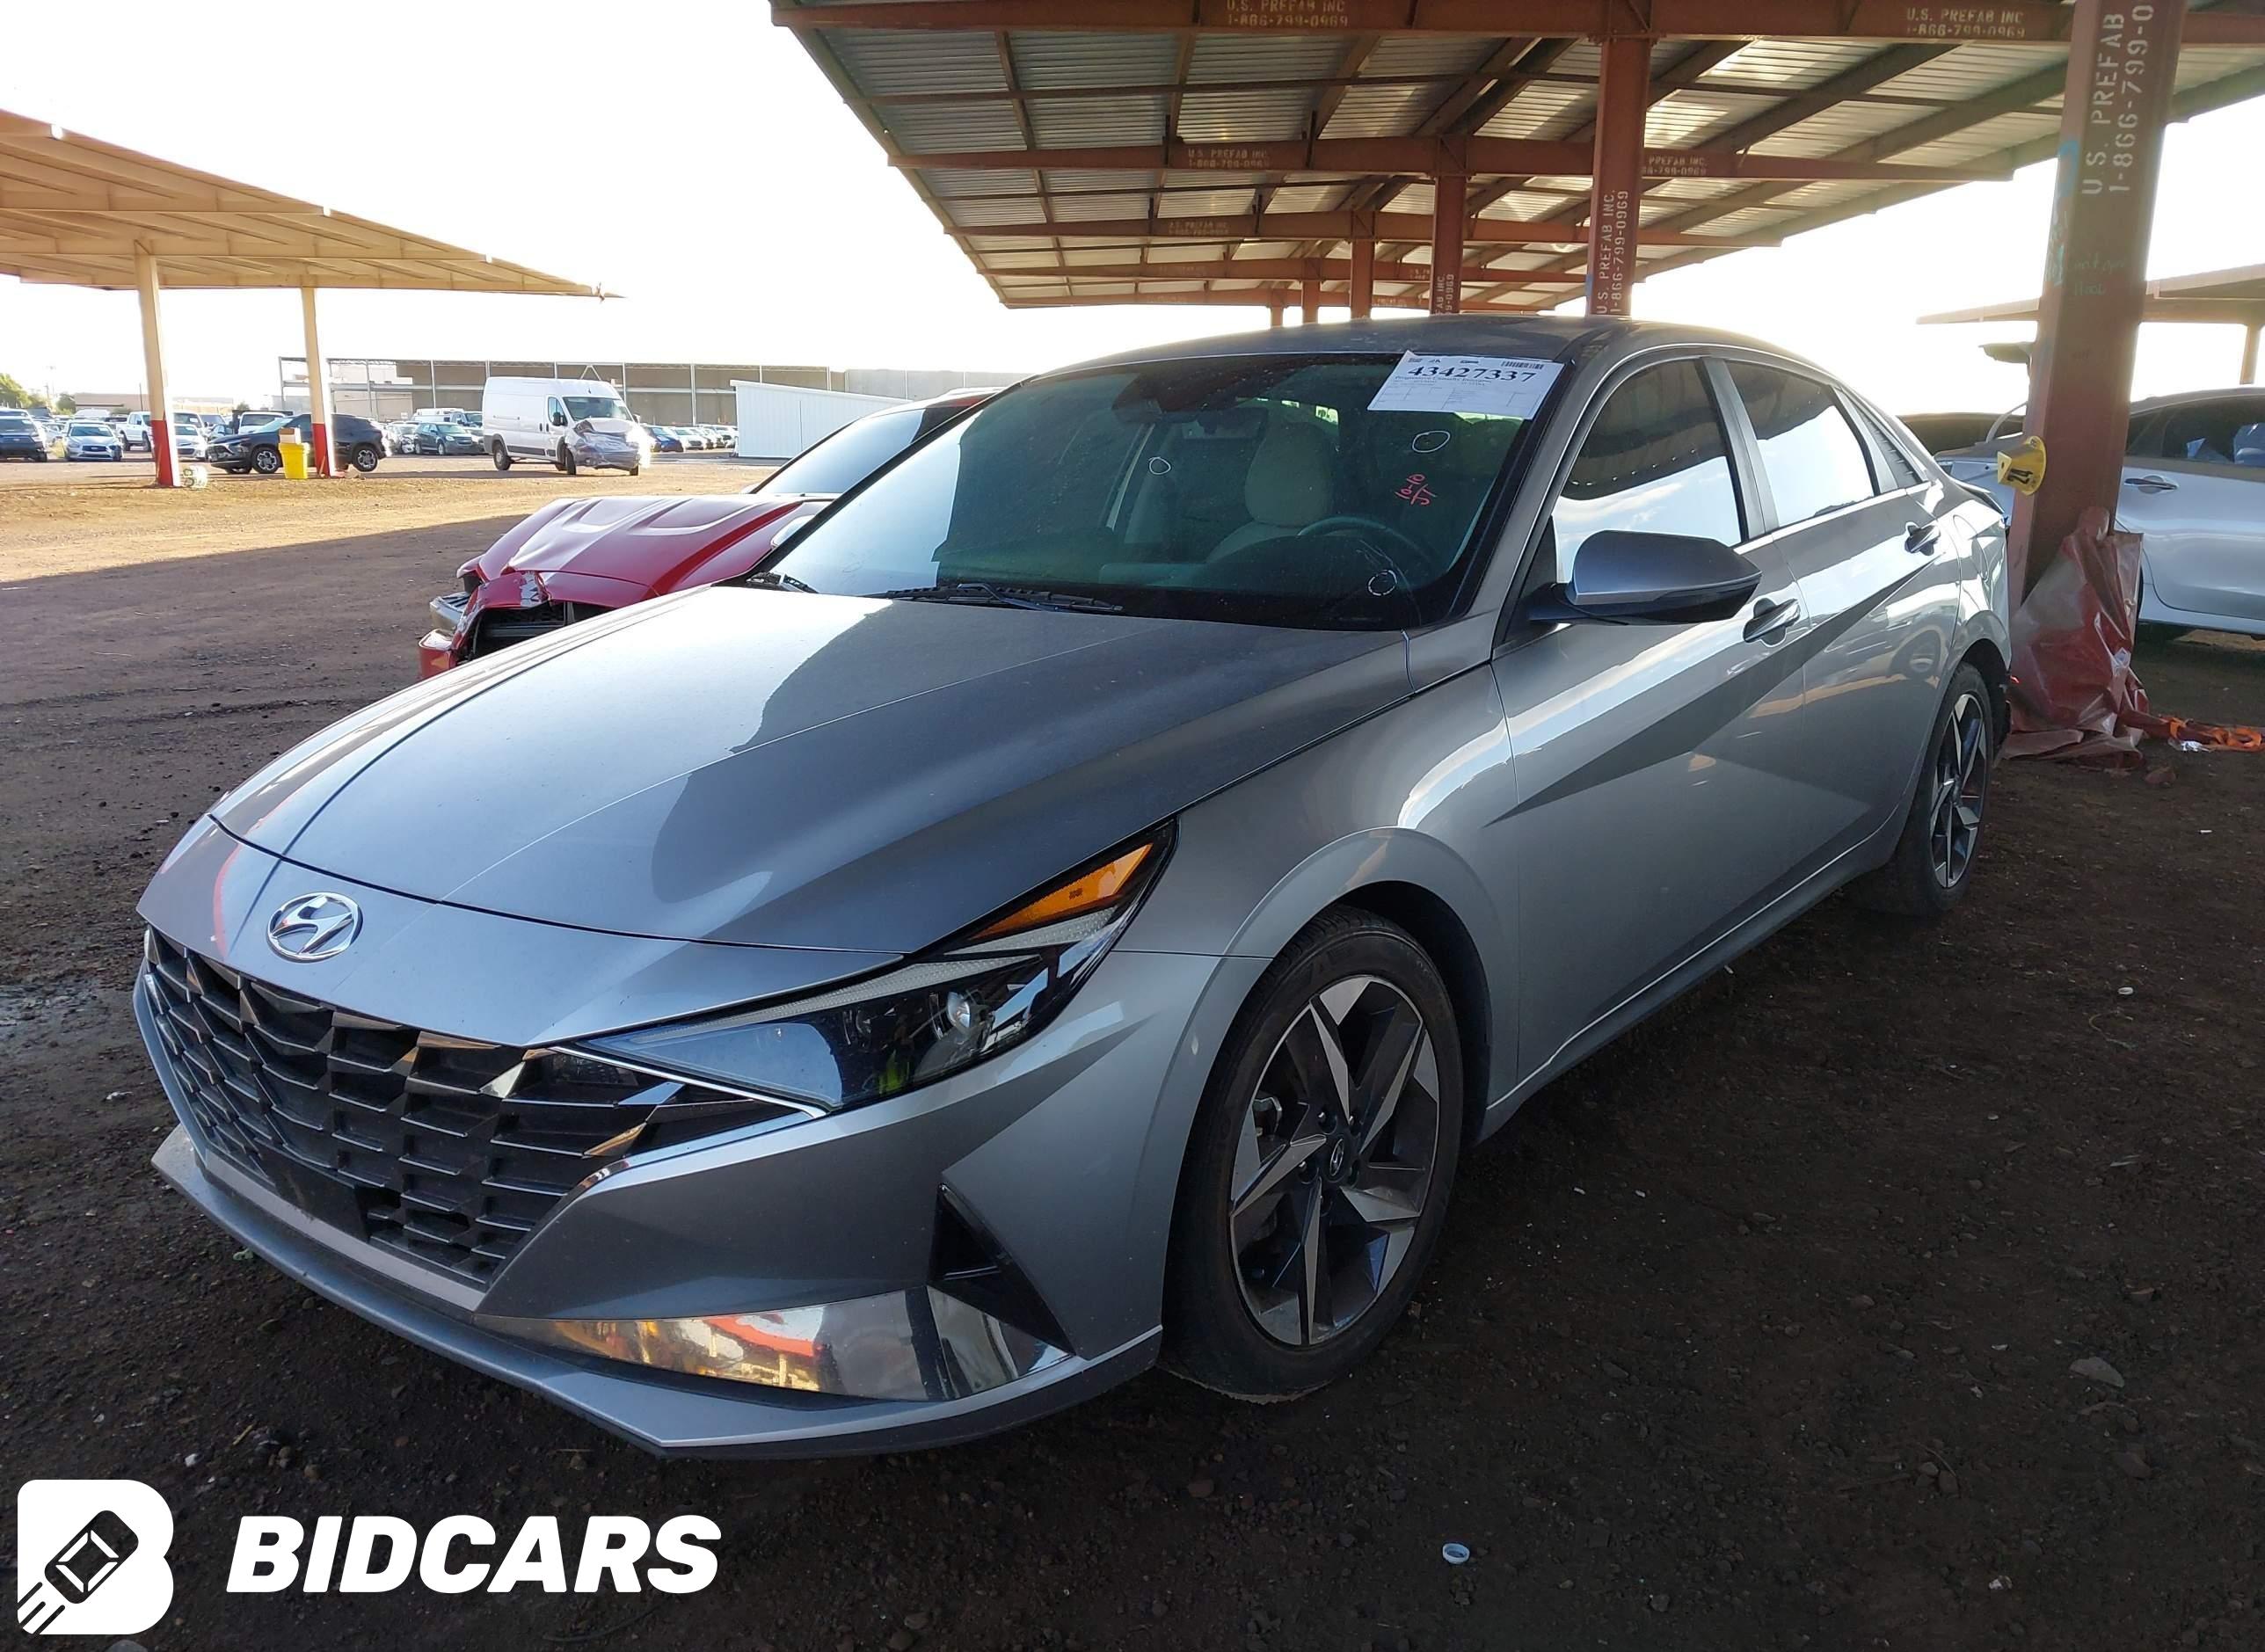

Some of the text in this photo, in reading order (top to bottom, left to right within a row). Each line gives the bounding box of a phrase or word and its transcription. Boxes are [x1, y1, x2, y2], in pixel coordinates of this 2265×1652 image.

[1261, 0, 1316, 12] PREFAB
[1906, 7, 1934, 21] U.S.
[1941, 8, 1995, 23] PREFAB
[2081, 13, 2124, 195] U.S. PREFAB
[2108, 4, 2154, 193] 1-866-799-0
[1596, 189, 1615, 315] U.S. PREFAB INC.
[1610, 190, 1628, 313] 1-866-799-0969
[1408, 366, 1537, 382] 43427337
